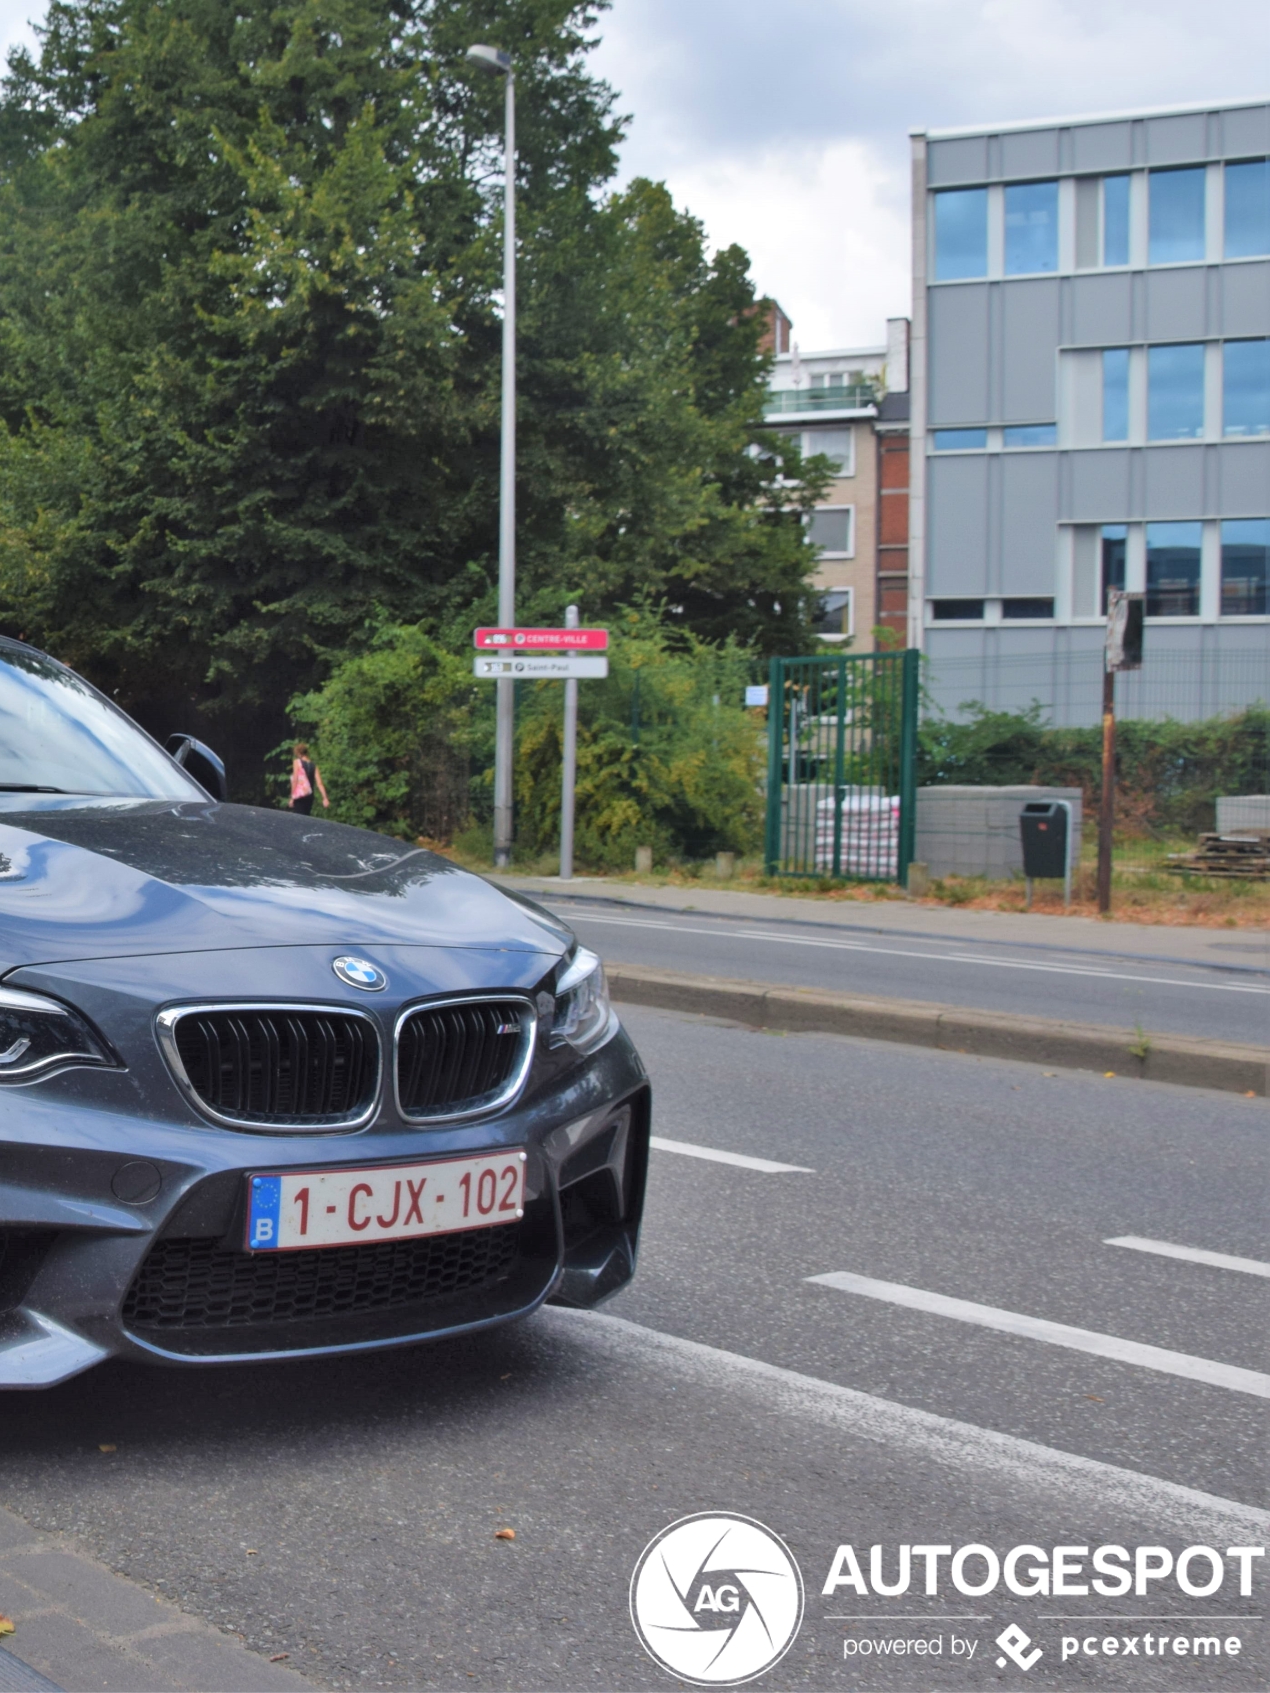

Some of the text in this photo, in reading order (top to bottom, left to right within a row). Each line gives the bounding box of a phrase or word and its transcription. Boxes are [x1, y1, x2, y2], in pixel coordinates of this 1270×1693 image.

[526, 634, 588, 644] CENTRE-VILLE
[527, 663, 569, 672] Saint-Paul
[335, 957, 372, 967] BMW
[255, 1165, 518, 1241] B 1-CJX-102
